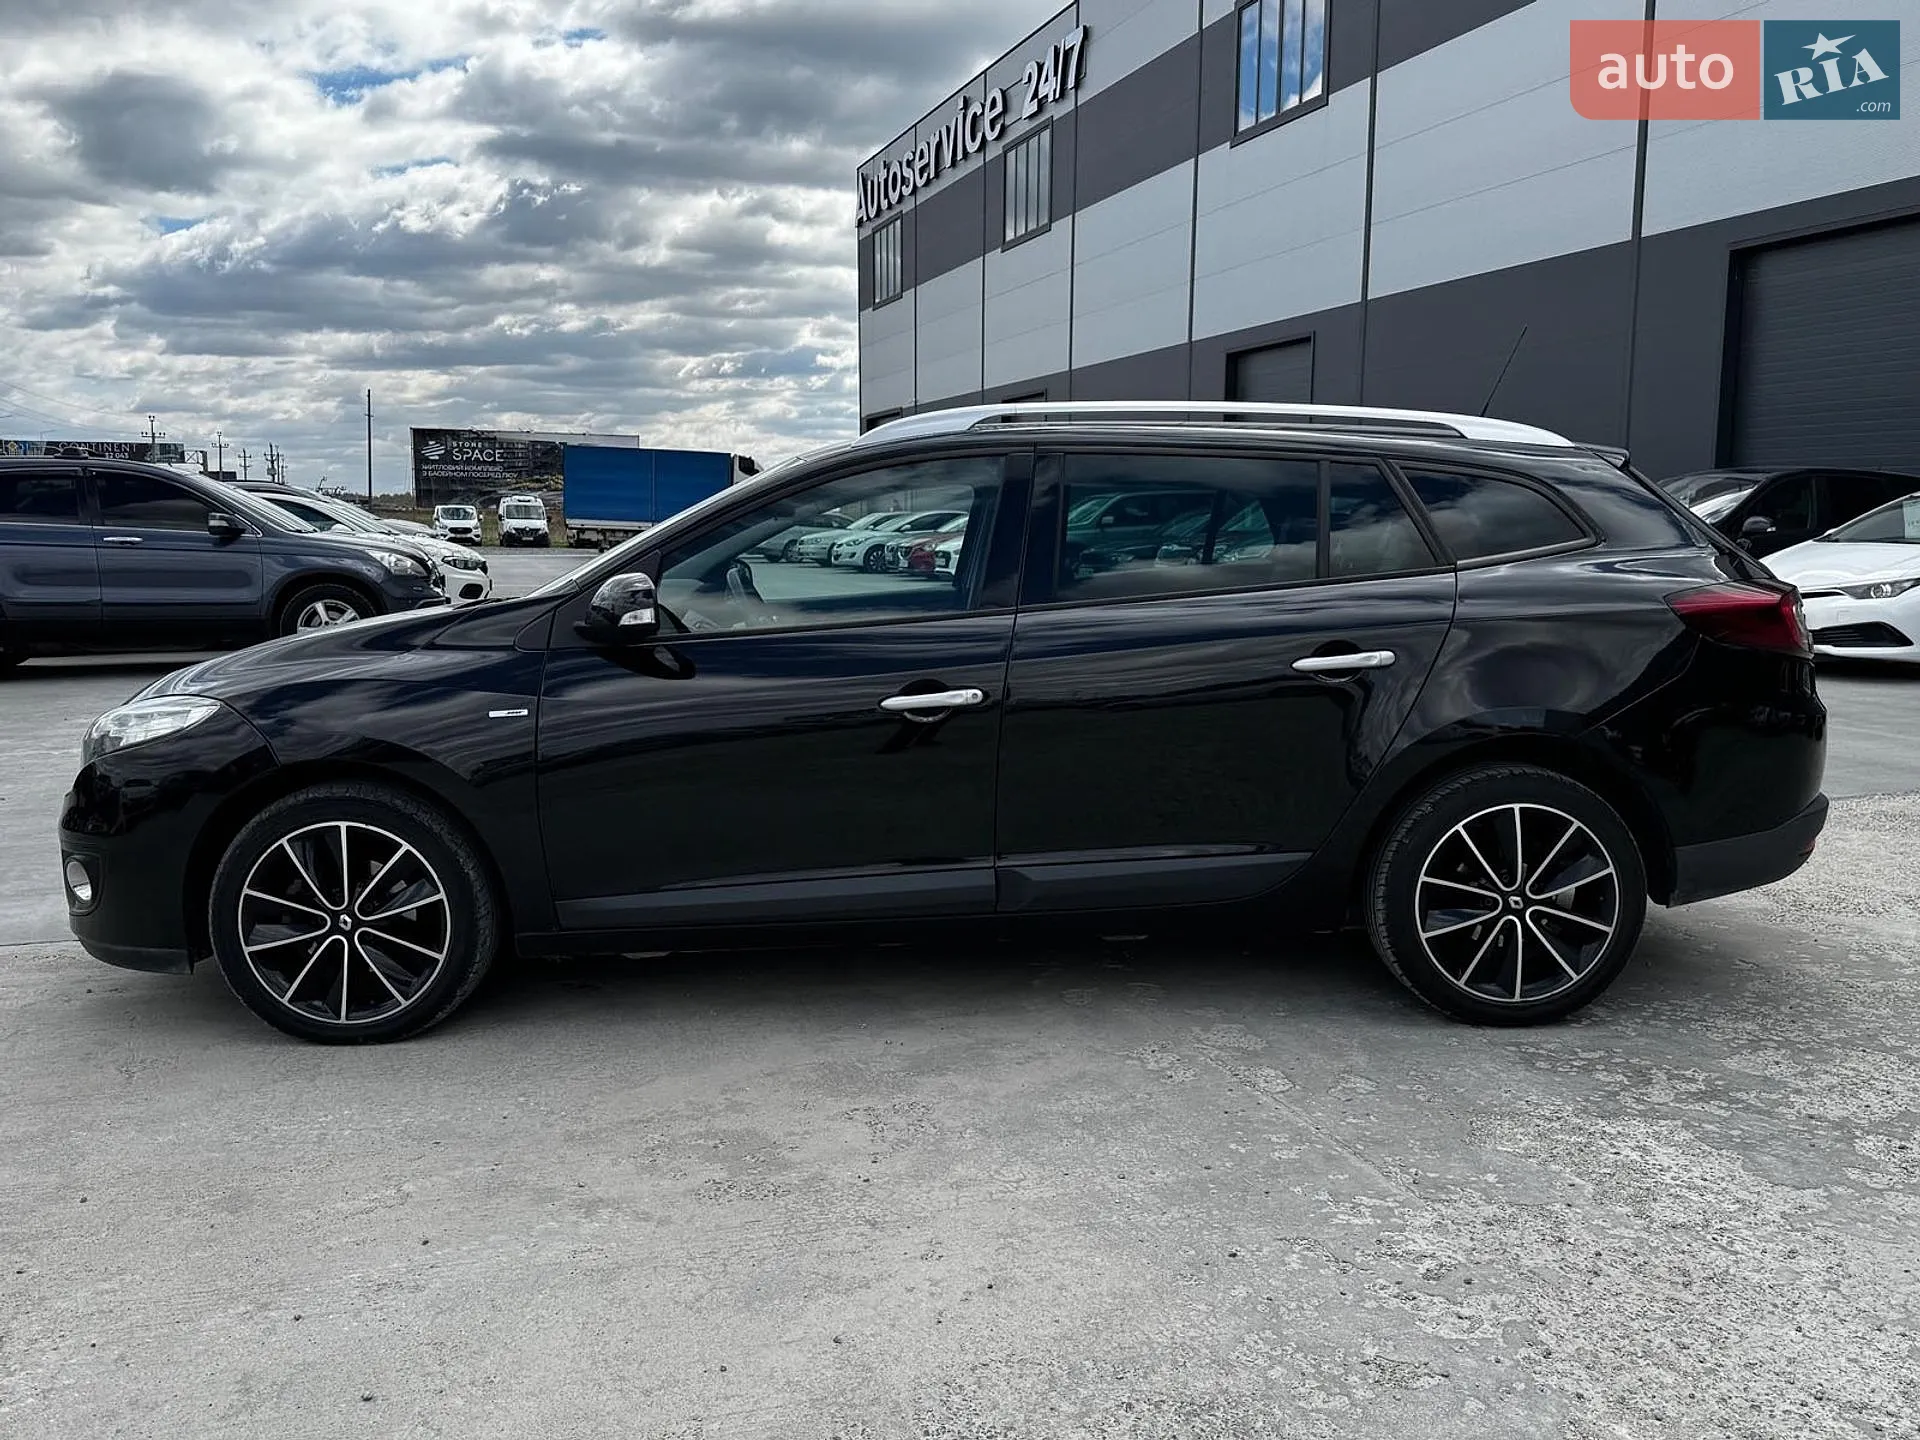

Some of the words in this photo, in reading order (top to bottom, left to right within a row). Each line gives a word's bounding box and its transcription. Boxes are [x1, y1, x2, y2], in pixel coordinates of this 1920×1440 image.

[856, 87, 1006, 224] Autoservice
[1022, 25, 1089, 120] 24/7
[452, 448, 504, 462] SPACE
